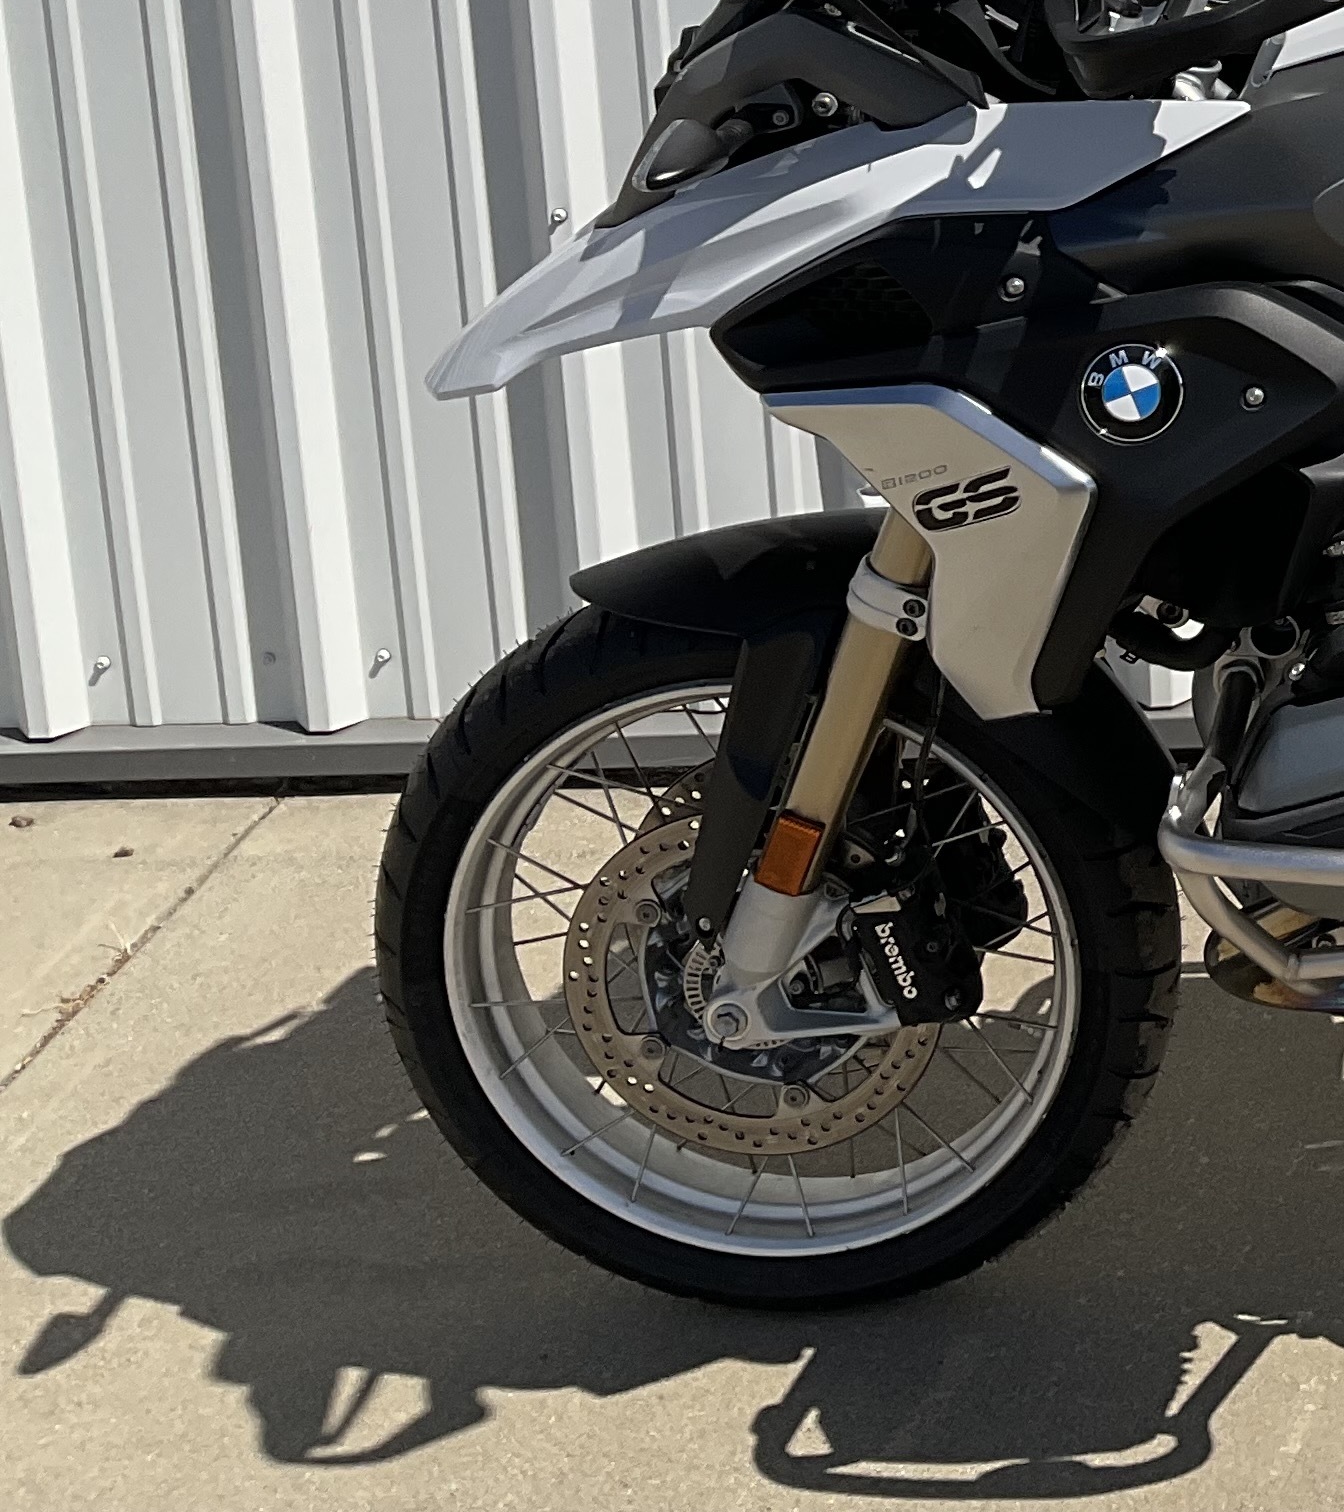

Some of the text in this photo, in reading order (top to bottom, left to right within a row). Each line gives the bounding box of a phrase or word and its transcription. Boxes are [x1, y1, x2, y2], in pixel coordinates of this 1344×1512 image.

[1087, 349, 1164, 388] BMW
[911, 464, 1023, 533] GS
[874, 921, 918, 999] brembo
